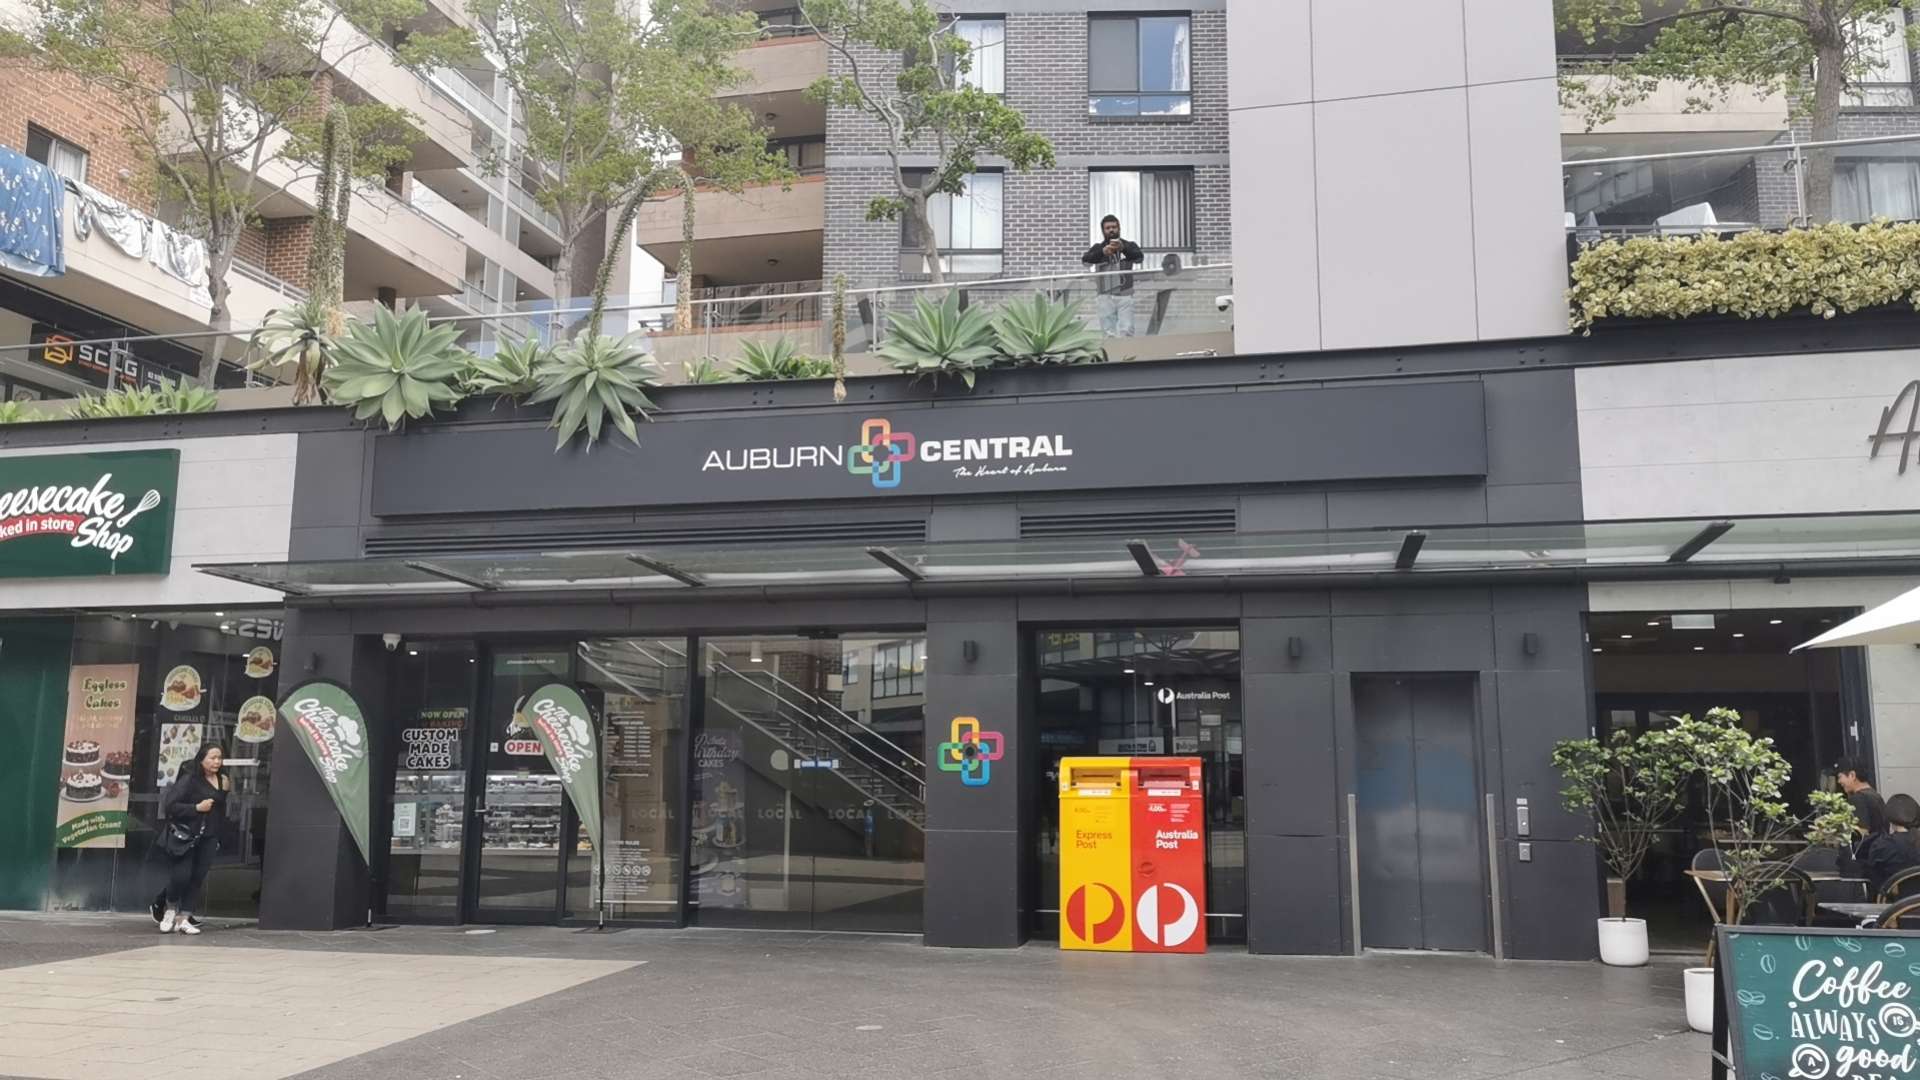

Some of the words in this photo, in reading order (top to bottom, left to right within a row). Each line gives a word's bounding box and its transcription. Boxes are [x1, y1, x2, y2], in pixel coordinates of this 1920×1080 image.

[1868, 380, 1920, 476] A
[702, 445, 843, 471] AUBURN
[920, 435, 1073, 462] CENTRAL
[953, 466, 972, 478] The
[975, 465, 1009, 477] Heart
[1010, 465, 1023, 475] of
[1024, 463, 1067, 475] Auburn
[26, 519, 38, 531] in
[41, 517, 75, 531] store
[71, 517, 134, 560] Shop
[83, 678, 127, 693] Eggless
[86, 696, 120, 708] Cakes
[1176, 692, 1211, 700] Australia
[1212, 692, 1230, 700] Post
[319, 706, 338, 724] The
[421, 711, 441, 719] NOW
[442, 710, 465, 719] OPEN
[554, 706, 571, 723] The
[294, 698, 353, 772] Cheesecake
[402, 729, 459, 741] CUSTOM
[533, 698, 584, 772] Cheesecake
[410, 742, 449, 755] MADE
[506, 742, 541, 752] OPEN
[319, 756, 337, 783] Shop
[406, 756, 451, 768] CAKES
[554, 756, 573, 783] Shop
[698, 759, 725, 768] CAKES
[71, 819, 89, 831] Made
[90, 815, 106, 823] with
[1076, 830, 1112, 841] Express
[1155, 830, 1199, 839] Australia
[1076, 840, 1097, 848] Post
[1155, 840, 1179, 849] Post
[1792, 958, 1911, 1008] Coffee
[1790, 1008, 1880, 1045] ALWAYS
[1893, 1016, 1905, 1026] IS
[1808, 1057, 1816, 1067] A
[1836, 1043, 1917, 1078] good
